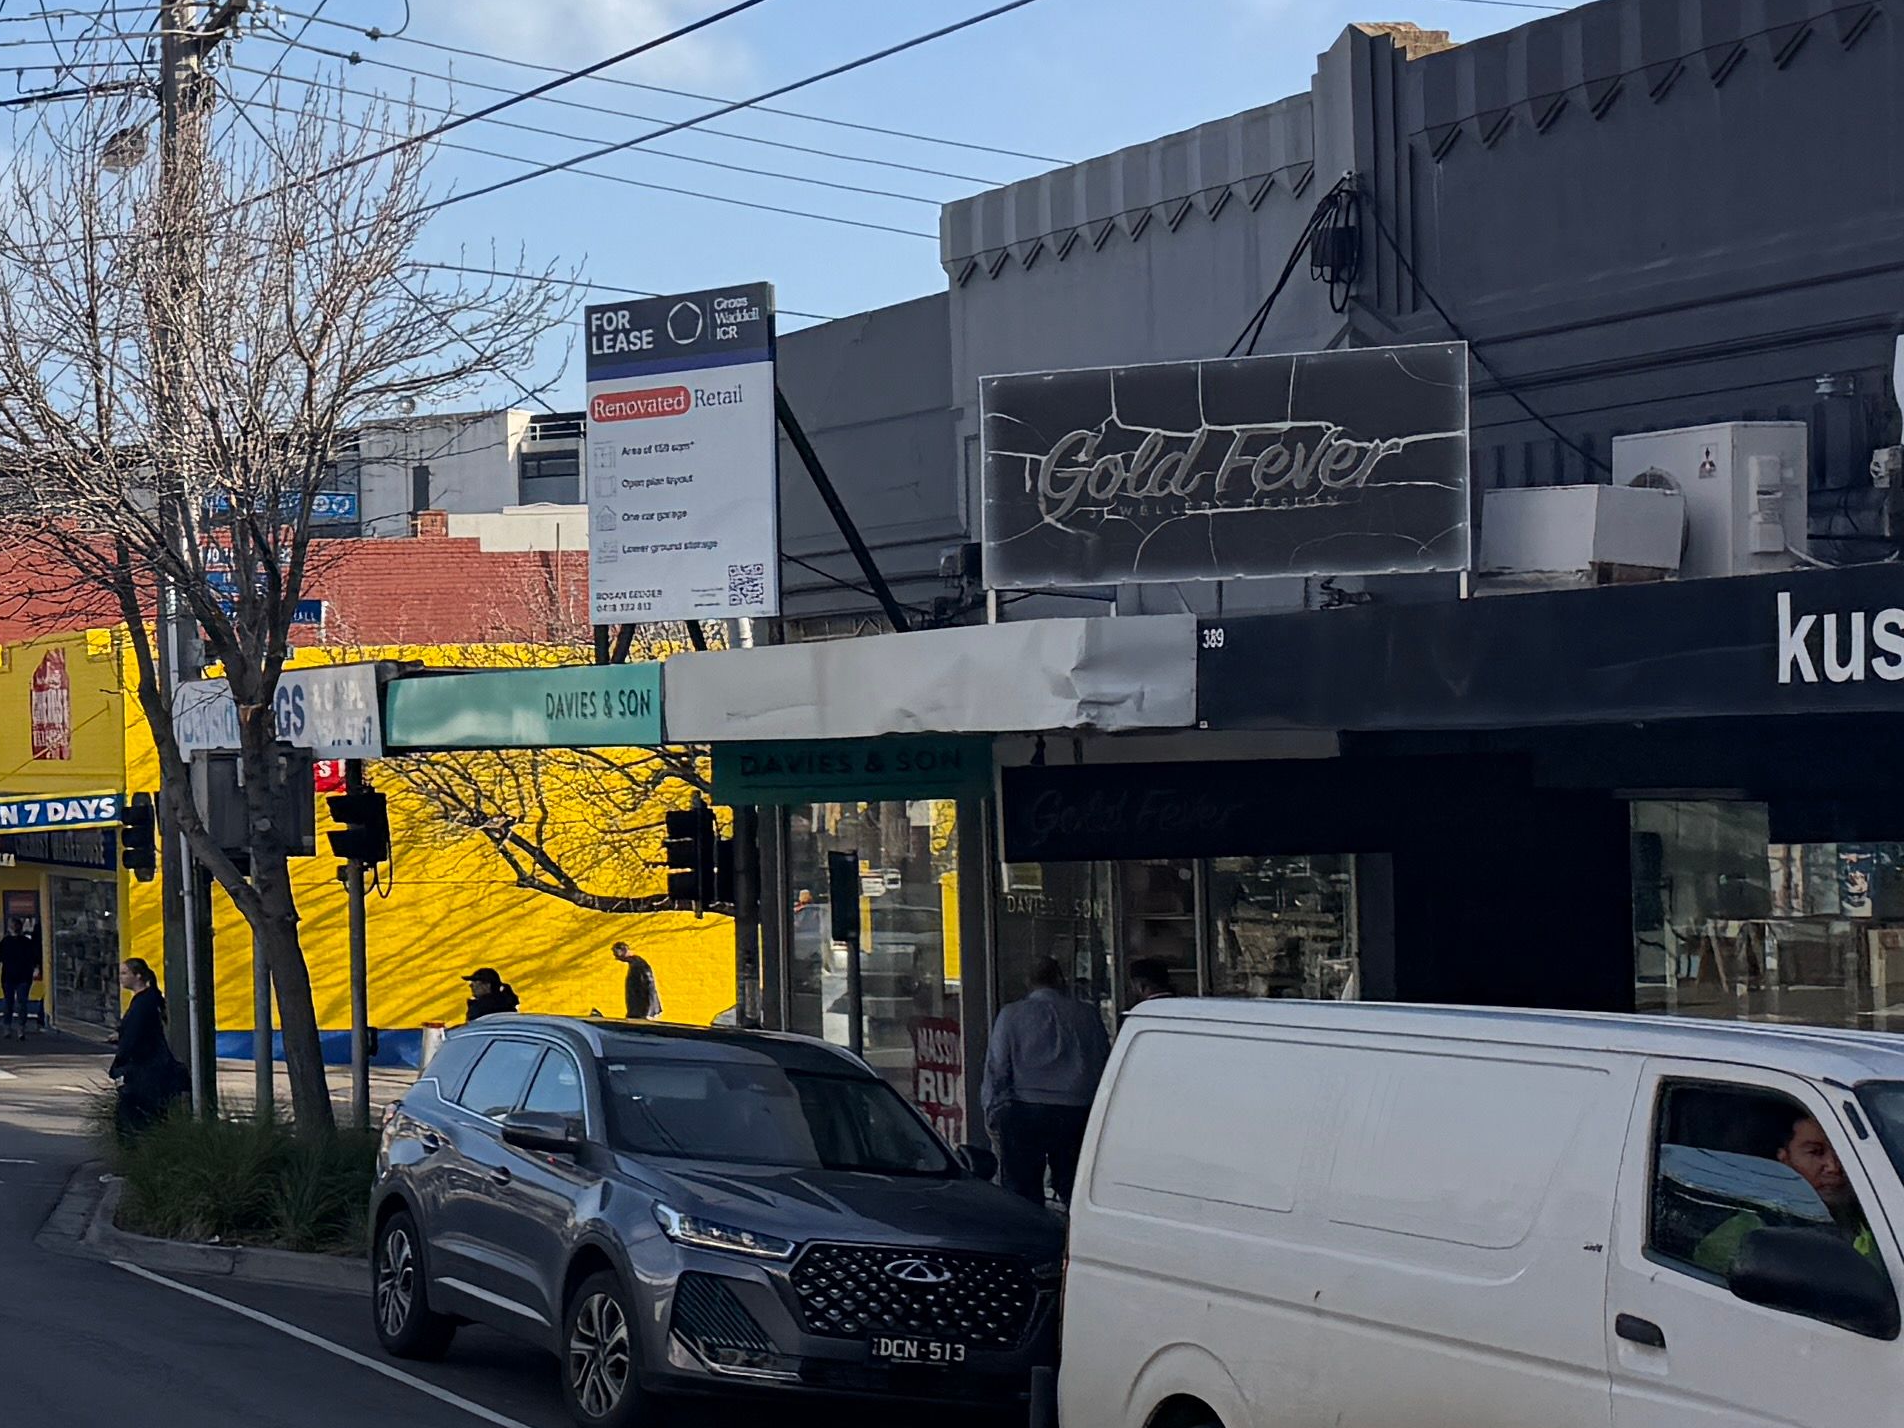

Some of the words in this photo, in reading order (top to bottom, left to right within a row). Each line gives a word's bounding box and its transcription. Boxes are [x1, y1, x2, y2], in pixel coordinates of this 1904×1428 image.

[591, 310, 630, 332] FOR
[716, 327, 738, 340] ICR
[591, 329, 654, 355] LEASE
[594, 391, 685, 419] Renovated
[694, 384, 743, 408] Retail
[1038, 428, 1208, 520] Gold
[1215, 427, 1396, 488] Fever
[1202, 628, 1224, 649] 389
[546, 689, 597, 720] DAVIES
[603, 690, 613, 717] &
[618, 688, 651, 718] SON
[26, 803, 39, 824] 7
[46, 797, 116, 822] DAYS
